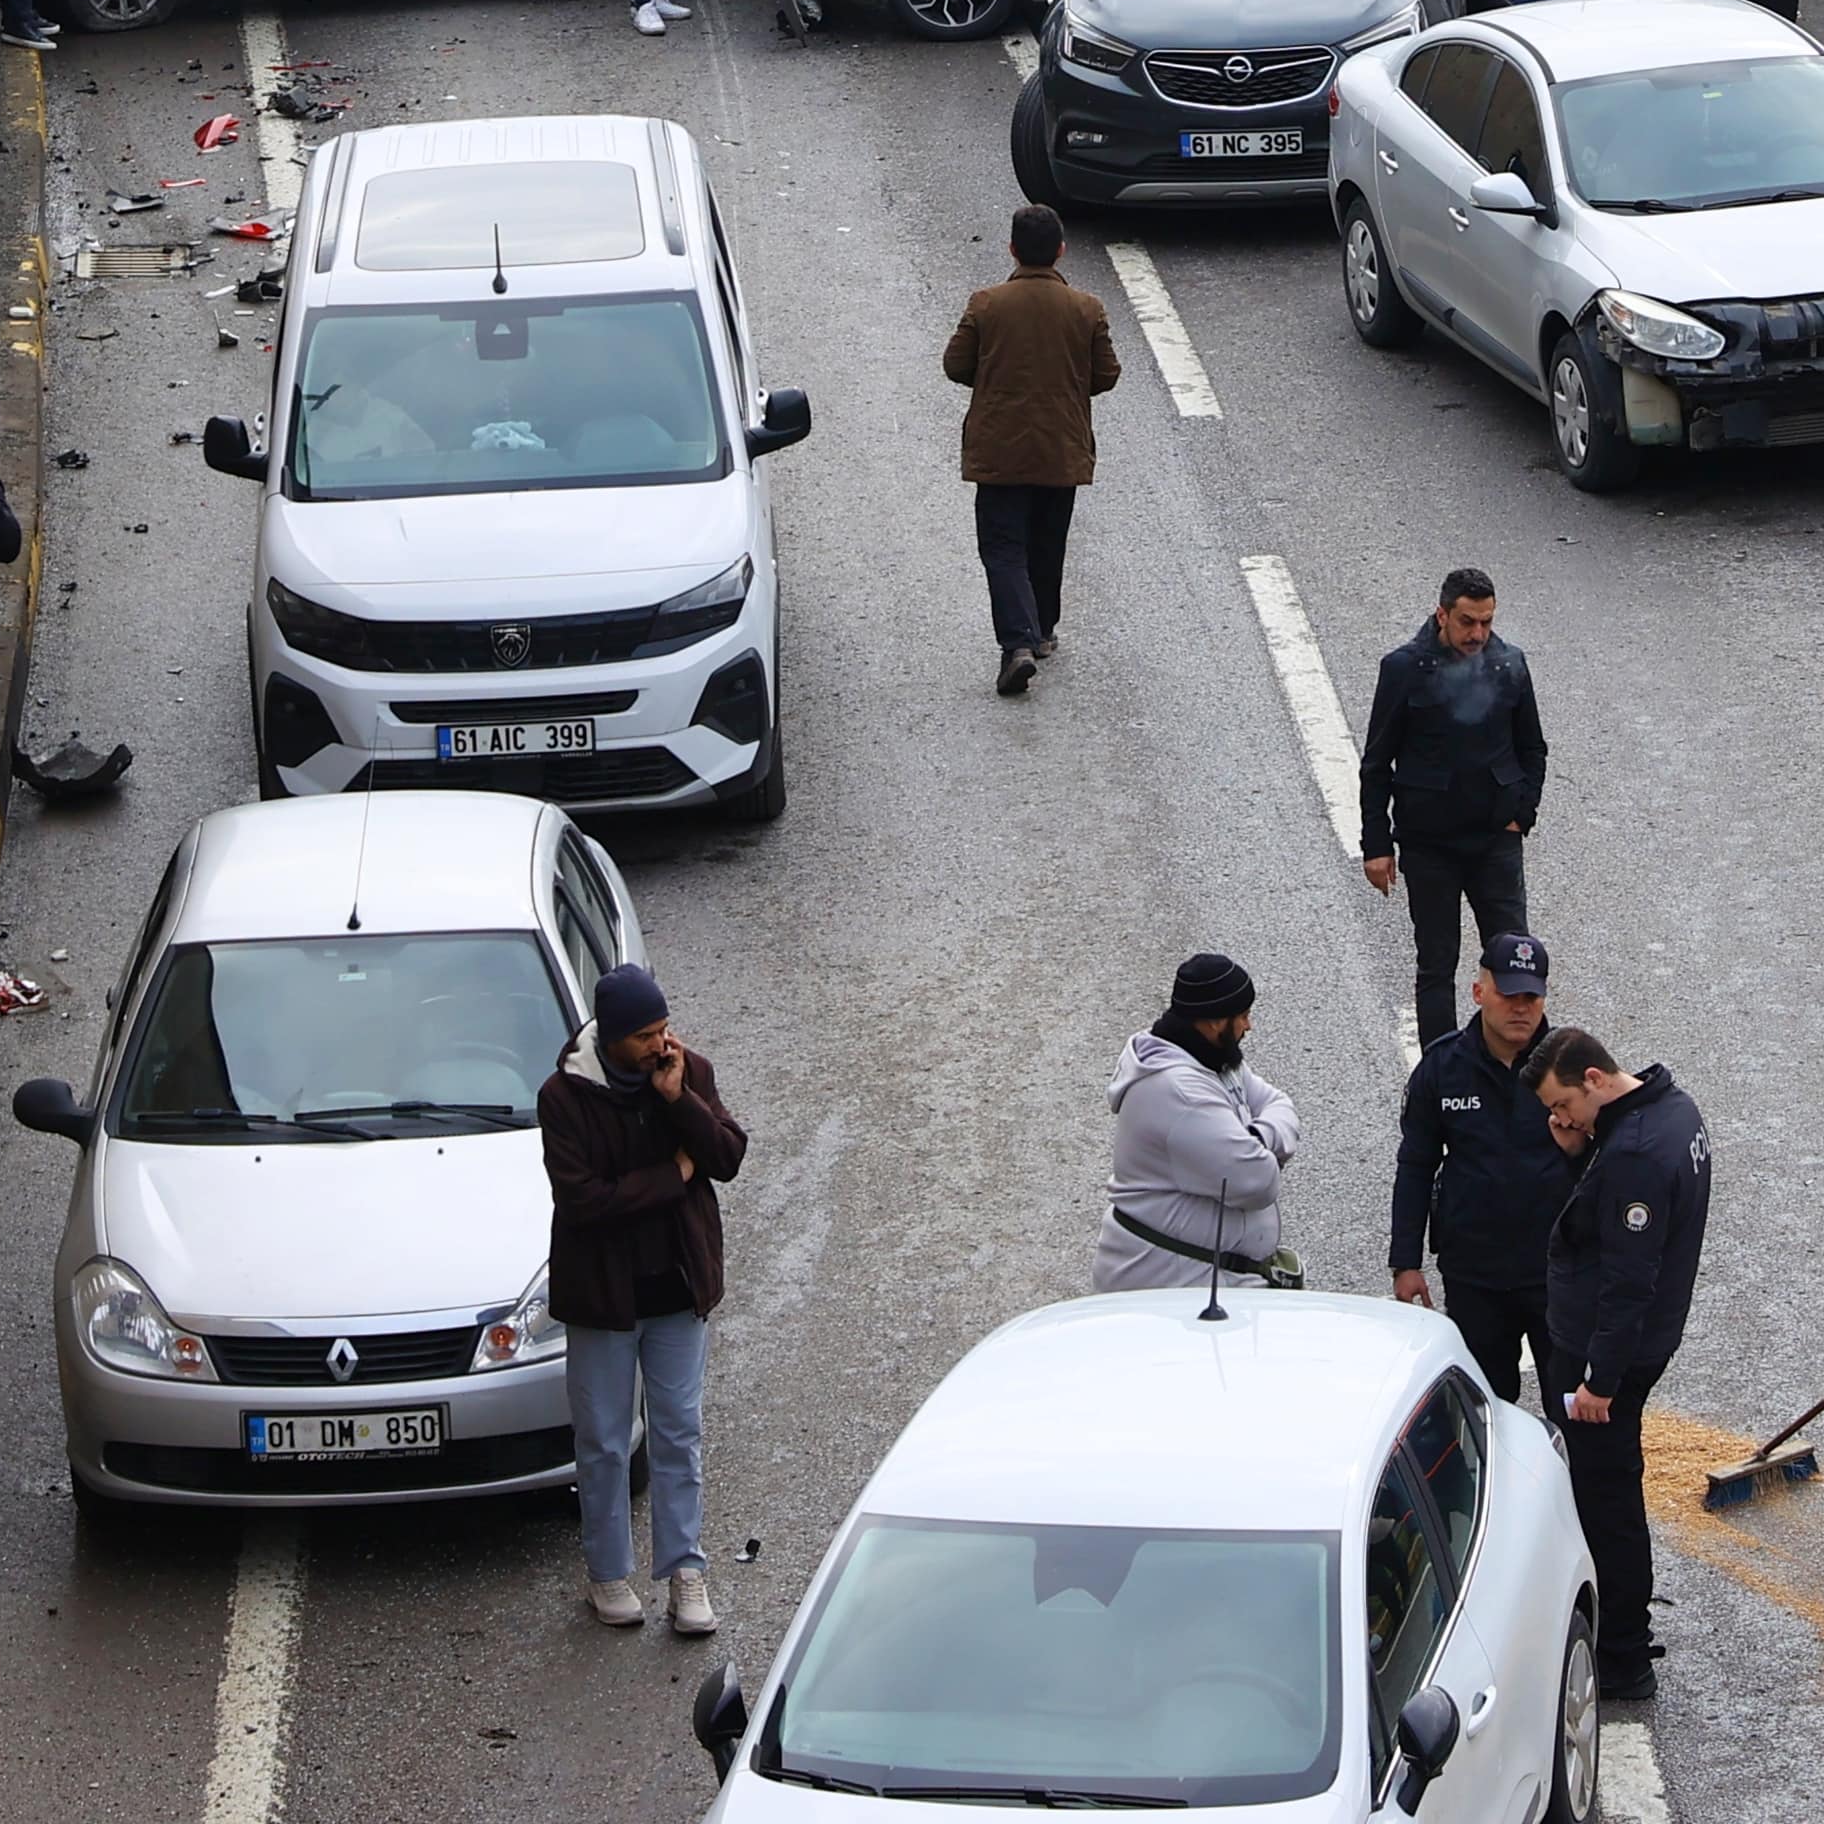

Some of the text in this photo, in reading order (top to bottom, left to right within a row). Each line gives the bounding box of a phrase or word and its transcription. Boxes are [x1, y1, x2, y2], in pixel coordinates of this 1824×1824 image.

[1192, 136, 1213, 155] 61
[1222, 135, 1250, 154] NC
[1259, 133, 1301, 153] 395
[454, 729, 477, 753] 61
[490, 727, 526, 753] AIC
[545, 723, 588, 749] 399
[267, 1421, 296, 1449] 01
[320, 1419, 356, 1448] DM
[385, 1414, 436, 1445] 850
[297, 1451, 367, 1462] OTOTECH
